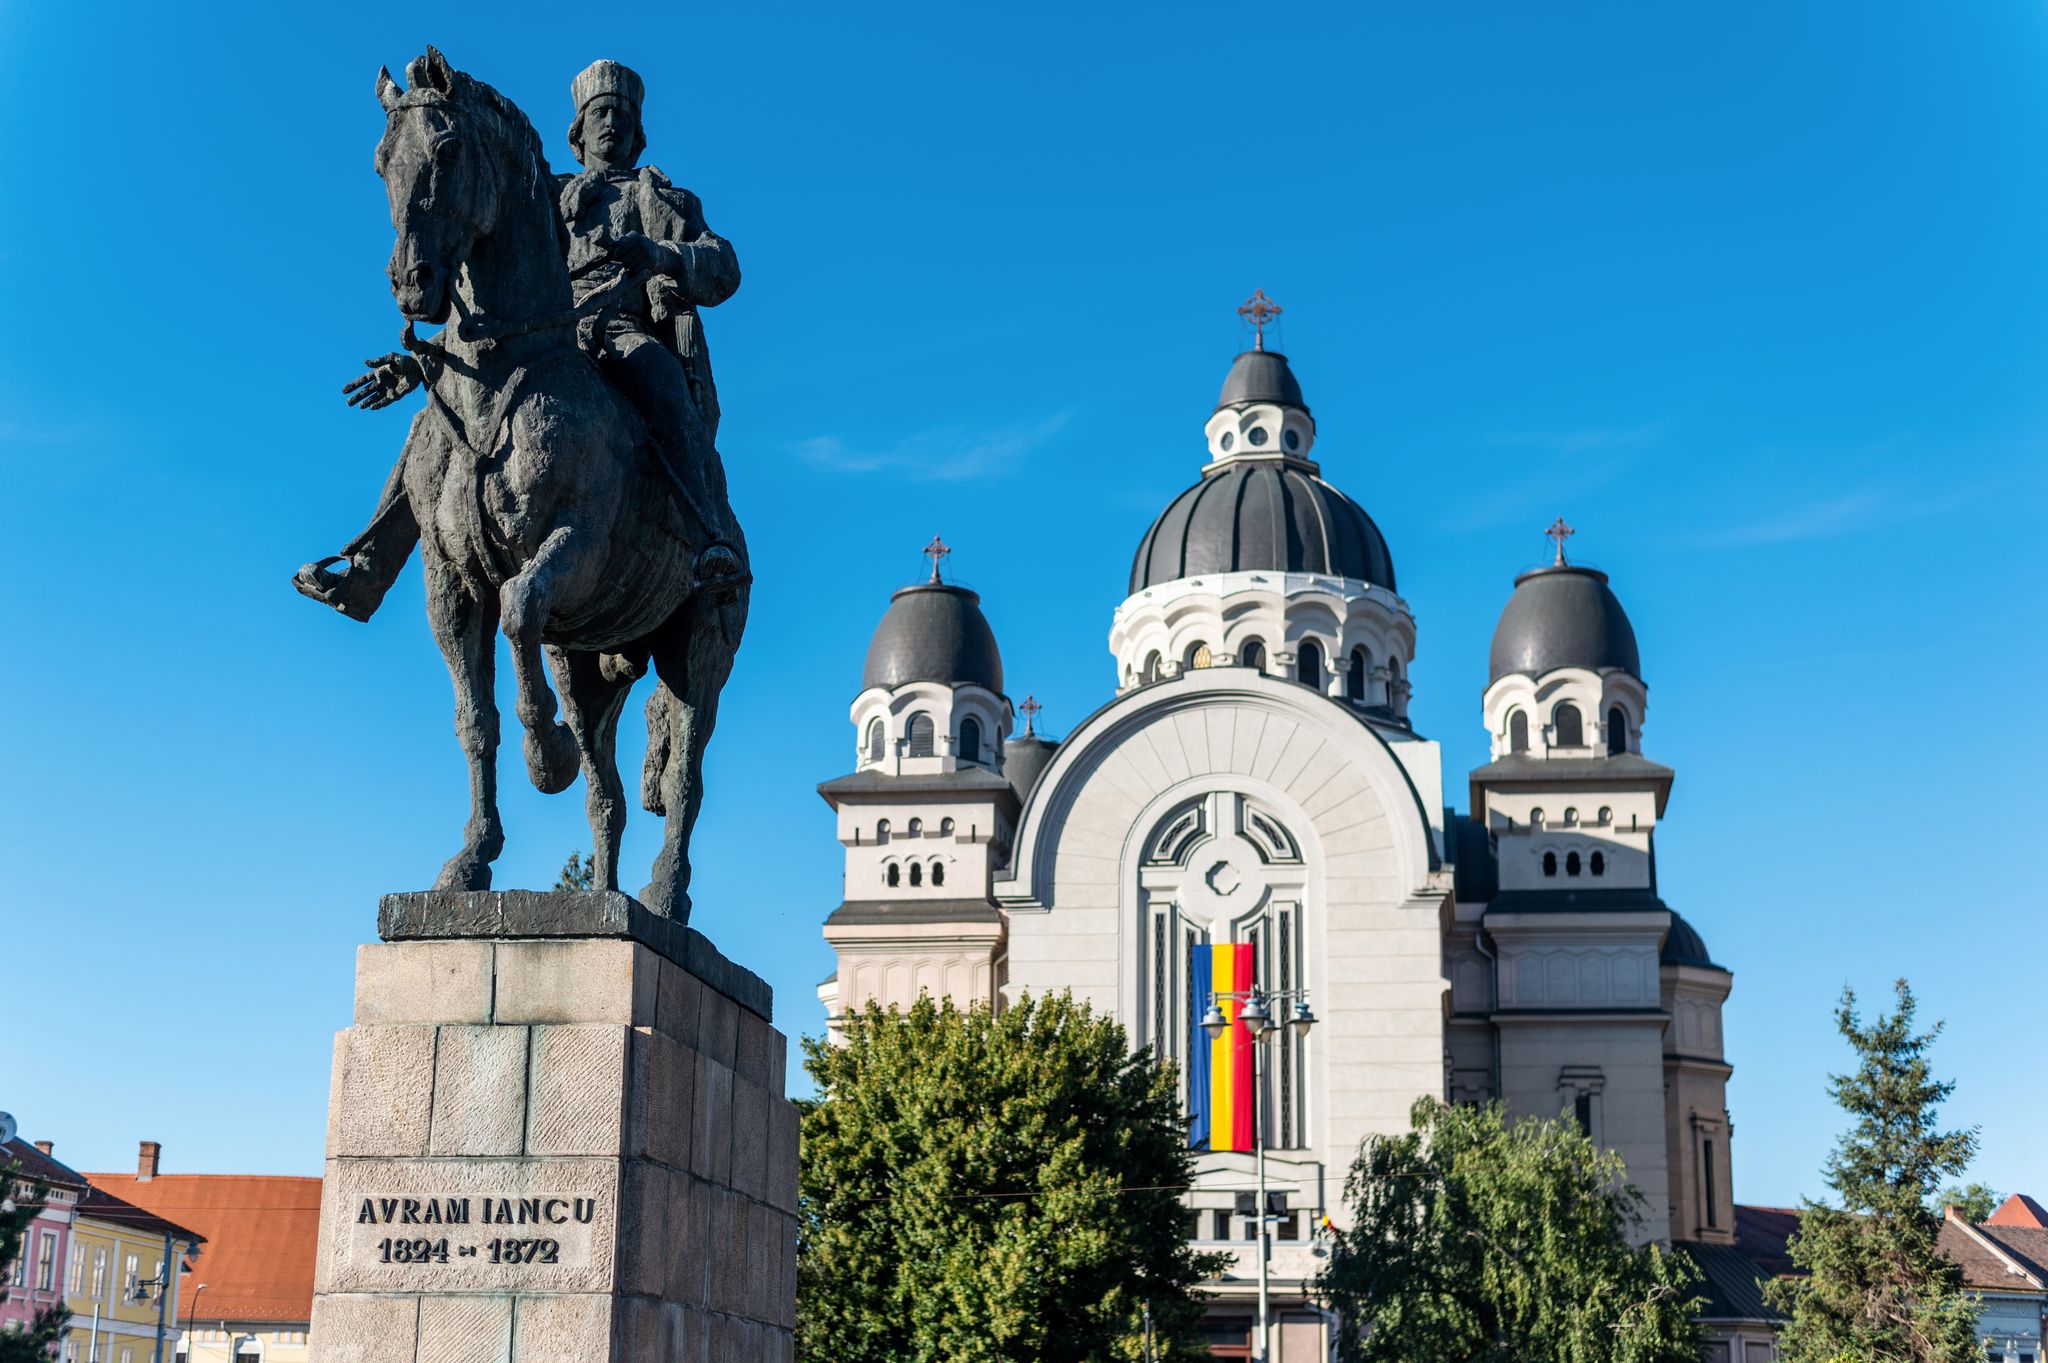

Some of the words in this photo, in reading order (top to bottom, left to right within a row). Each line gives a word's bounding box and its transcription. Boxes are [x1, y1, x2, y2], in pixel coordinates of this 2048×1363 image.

[357, 1198, 470, 1224] AVRAM
[480, 1198, 596, 1224] IANCU
[377, 1237, 449, 1264] 1824
[487, 1237, 559, 1264] 1872
